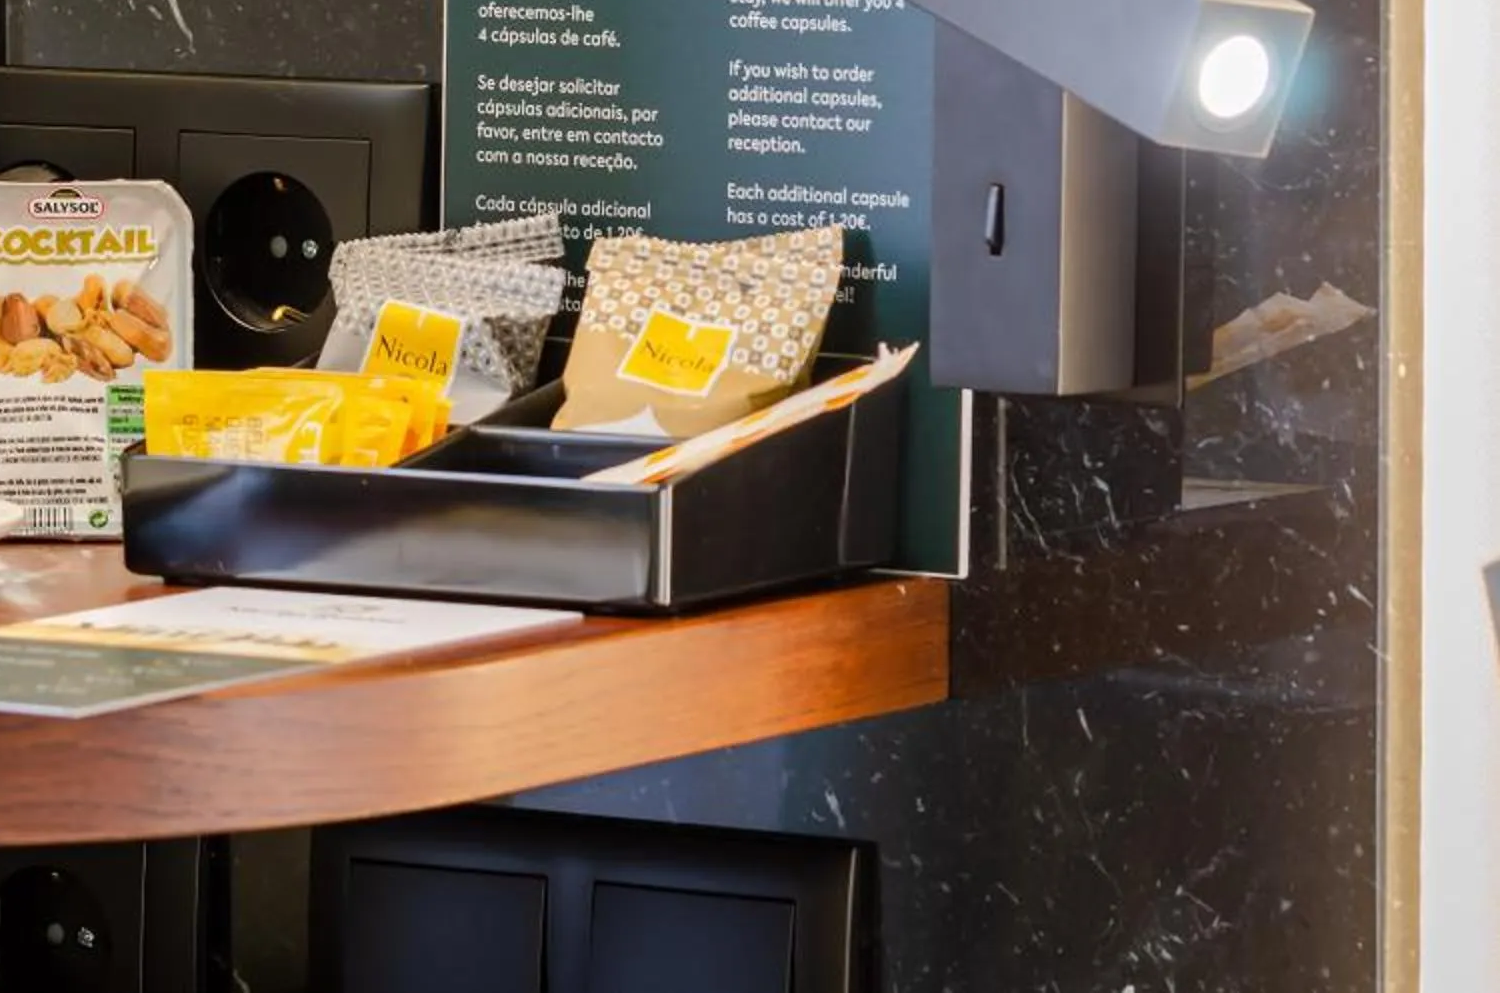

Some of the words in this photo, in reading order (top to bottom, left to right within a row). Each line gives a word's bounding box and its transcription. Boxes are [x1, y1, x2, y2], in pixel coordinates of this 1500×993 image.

[477, 1, 595, 23] oferecemos-lhe
[729, 11, 778, 30] coffee
[780, 15, 853, 34] capsules.
[477, 27, 487, 42] 4
[490, 26, 557, 47] cápsulas
[560, 28, 580, 46] de
[582, 29, 621, 48] café.
[728, 60, 743, 76] If
[743, 64, 771, 82] you
[773, 63, 808, 80] wish
[811, 64, 830, 81] to
[832, 66, 875, 82] order
[476, 74, 496, 91] Se
[499, 74, 555, 96] desejar
[558, 77, 620, 96] solicitar
[728, 85, 808, 105] additional
[811, 88, 883, 109] capsules,
[476, 98, 543, 118] cápsulas
[545, 101, 629, 123] adicionais,
[631, 107, 659, 125] por
[727, 108, 778, 129] please
[781, 114, 842, 131] contact
[845, 117, 873, 132] our
[475, 121, 519, 142] favor,
[521, 125, 563, 142] entre
[566, 128, 591, 143] em
[593, 129, 664, 147] contacto
[727, 134, 806, 155] reception.
[475, 149, 509, 163] com
[511, 151, 522, 164] a
[525, 152, 569, 167] nossa
[572, 153, 638, 173] receção.
[32, 201, 99, 214] SALYSOL
[475, 193, 516, 212] Cada
[518, 195, 578, 216] cápsula
[580, 199, 652, 220] adicional
[726, 182, 764, 201] Each
[767, 184, 847, 205] additional
[850, 190, 910, 209] capsule
[726, 206, 754, 225] has
[757, 211, 768, 225] a
[771, 209, 805, 227] cost
[808, 210, 827, 229] of
[828, 212, 872, 231] 120€.
[583, 223, 603, 240] de
[838, 262, 898, 281] nderful
[376, 334, 448, 377] Nicola
[639, 338, 716, 375] Nicola
